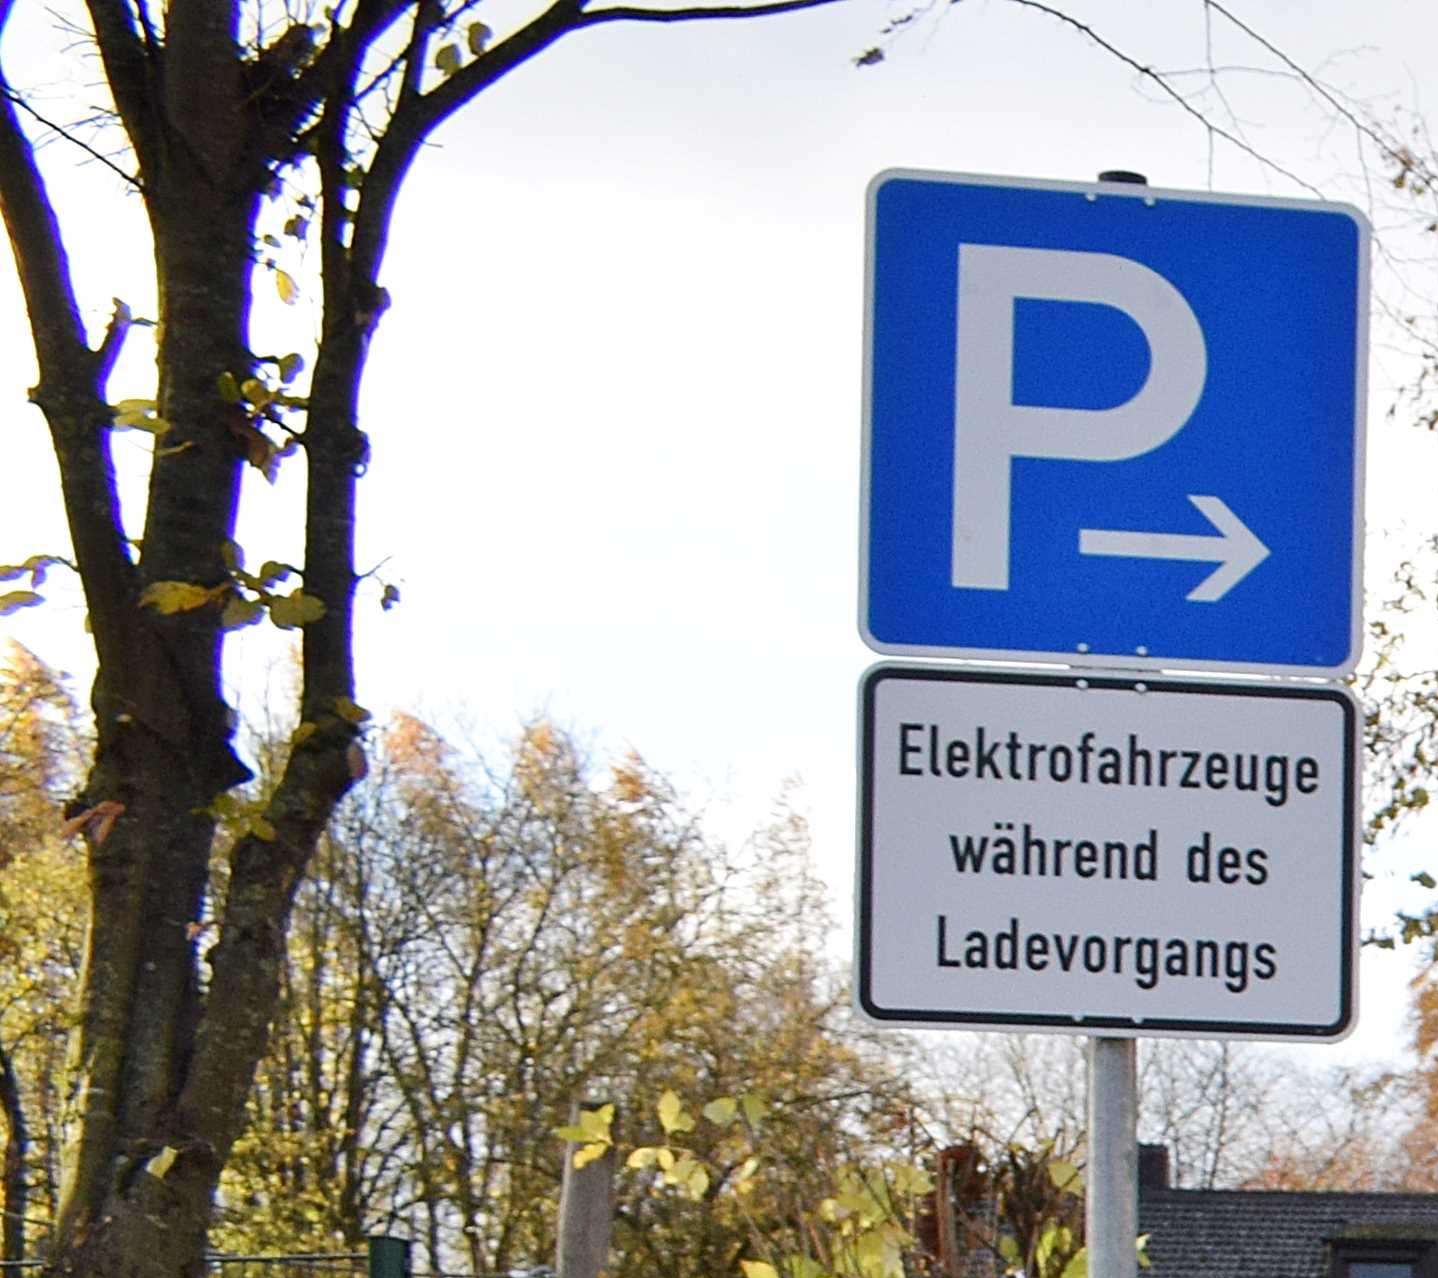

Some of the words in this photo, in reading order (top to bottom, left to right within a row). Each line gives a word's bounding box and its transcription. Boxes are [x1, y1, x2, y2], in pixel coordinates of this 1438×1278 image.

[952, 243, 1207, 590] P
[899, 722, 1319, 808] Elektrofahrzeuge
[948, 821, 1158, 882] während
[1186, 831, 1269, 886] des
[937, 914, 1277, 994] Ladevorgangs
